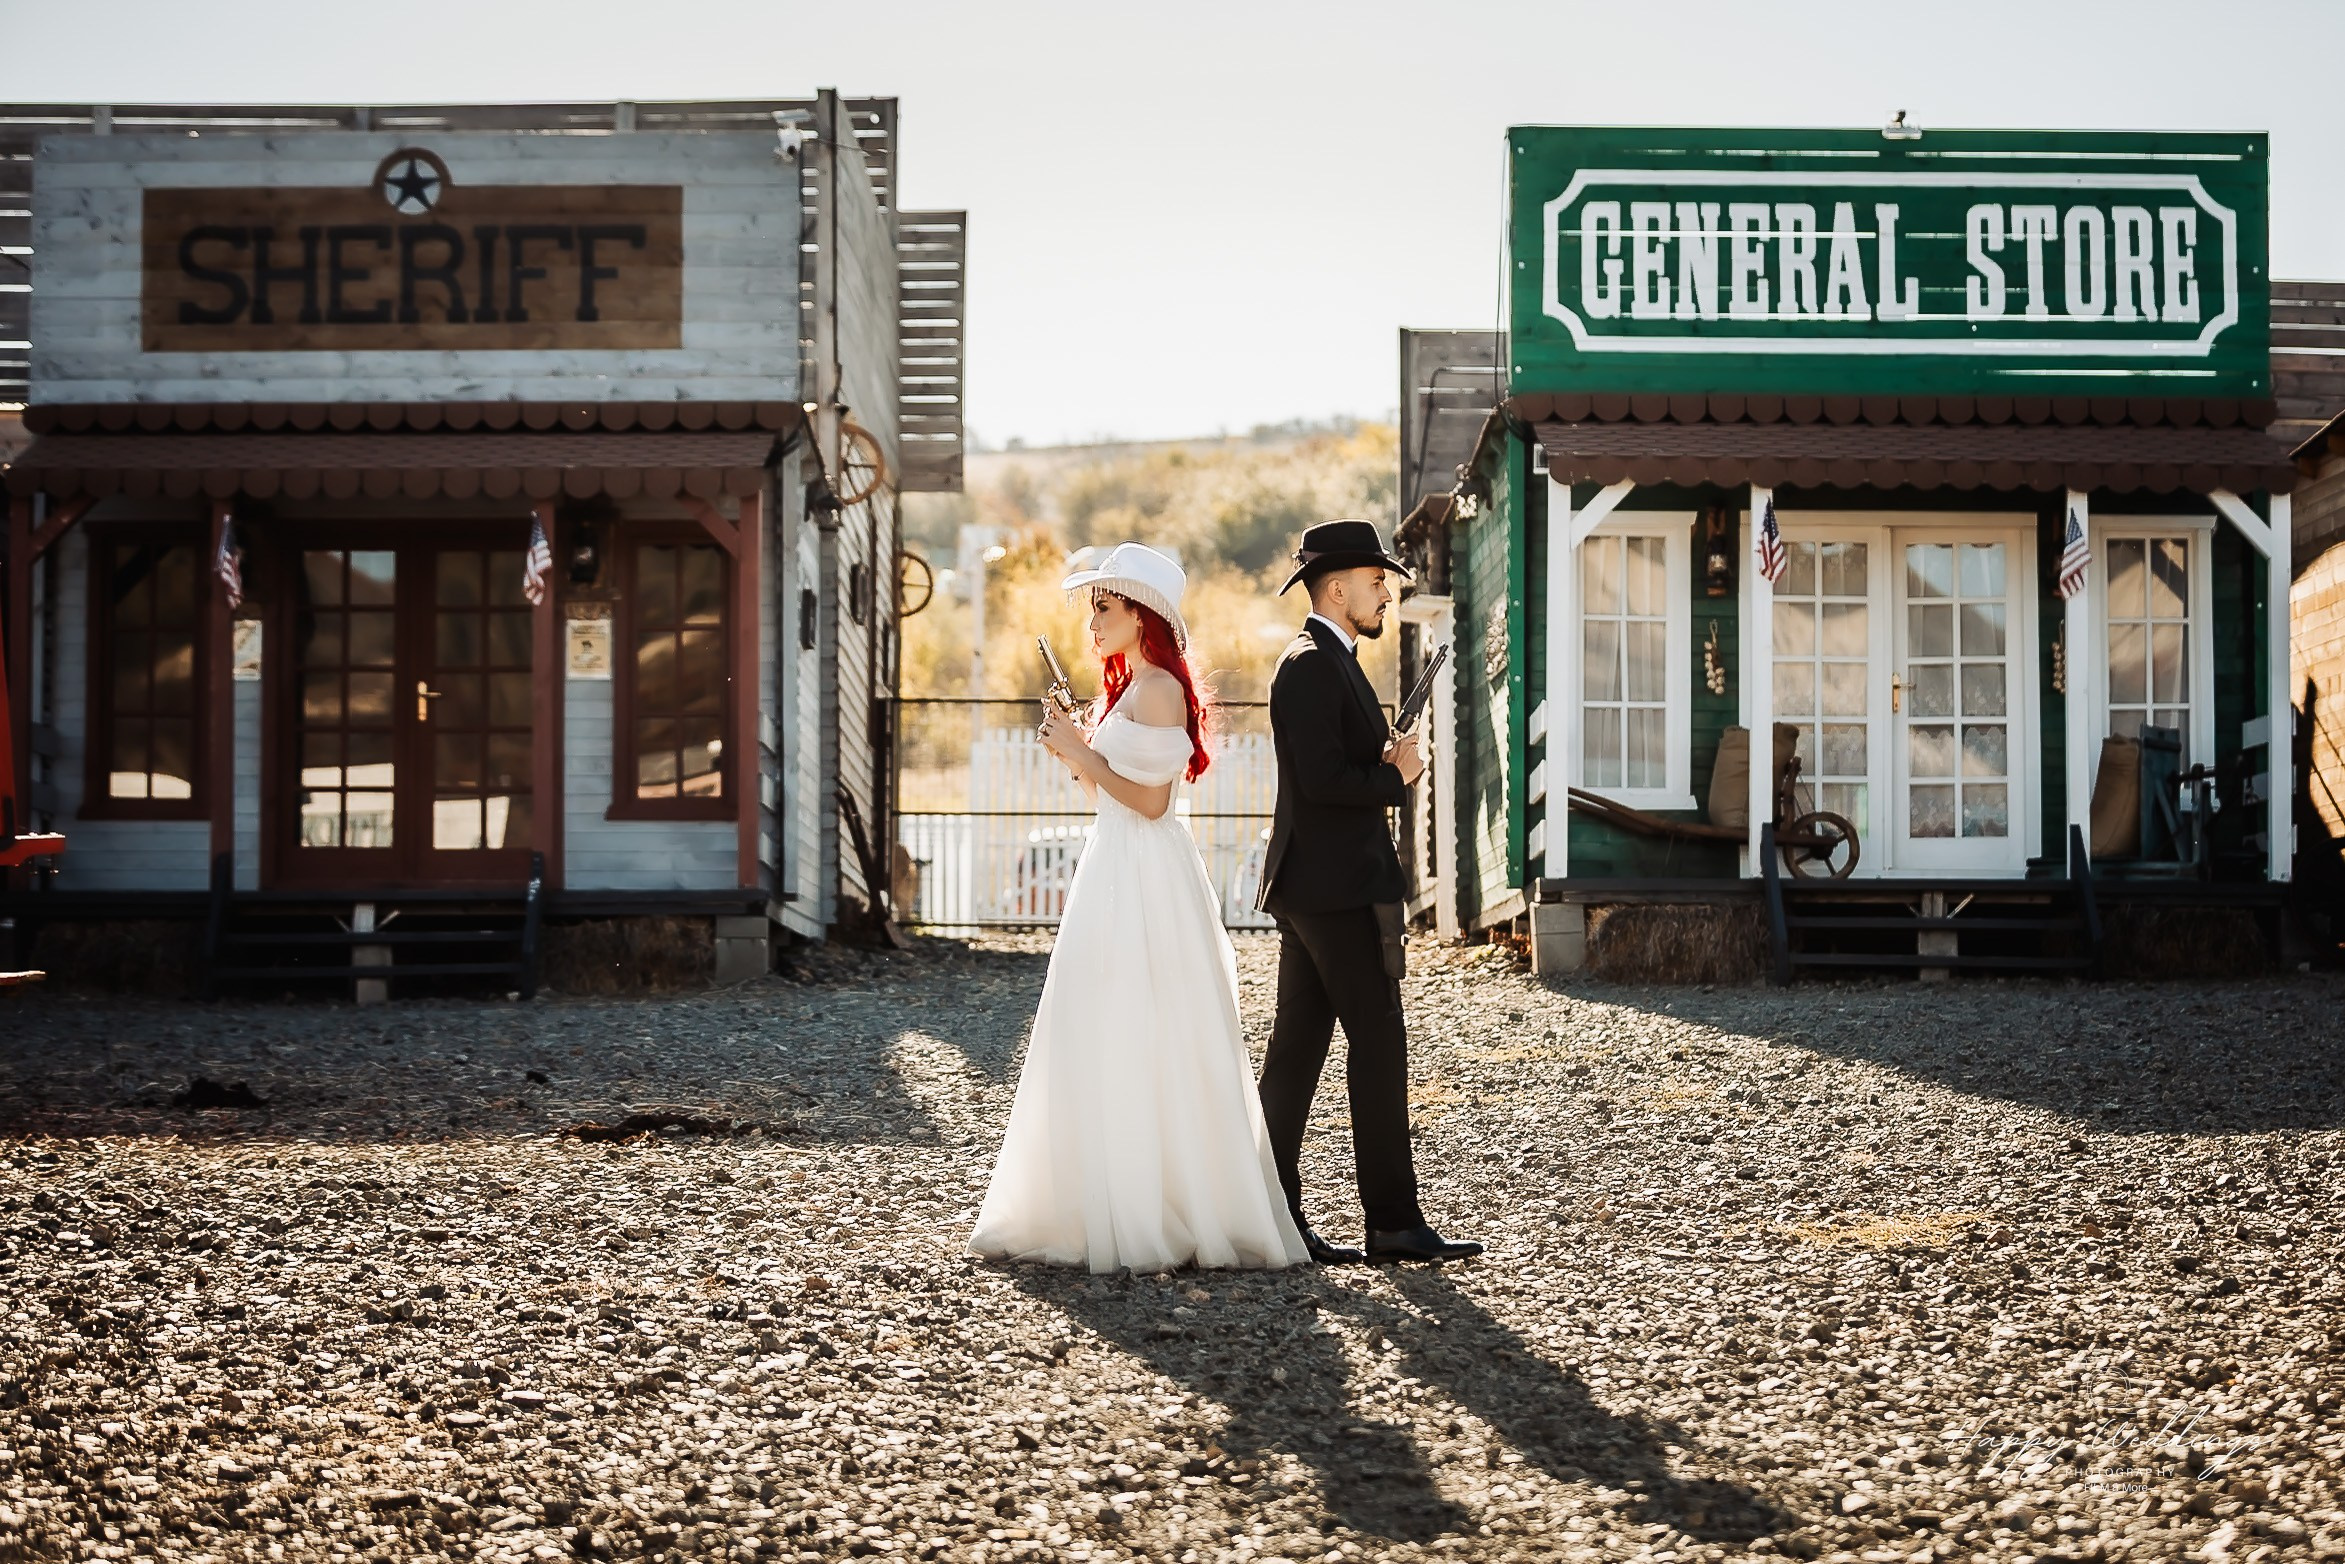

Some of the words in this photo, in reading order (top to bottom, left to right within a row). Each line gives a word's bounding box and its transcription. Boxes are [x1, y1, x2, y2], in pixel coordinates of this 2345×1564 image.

[178, 224, 647, 325] SHERIFF
[1580, 201, 1919, 322] GENERAL
[1966, 204, 2200, 324] STORE
